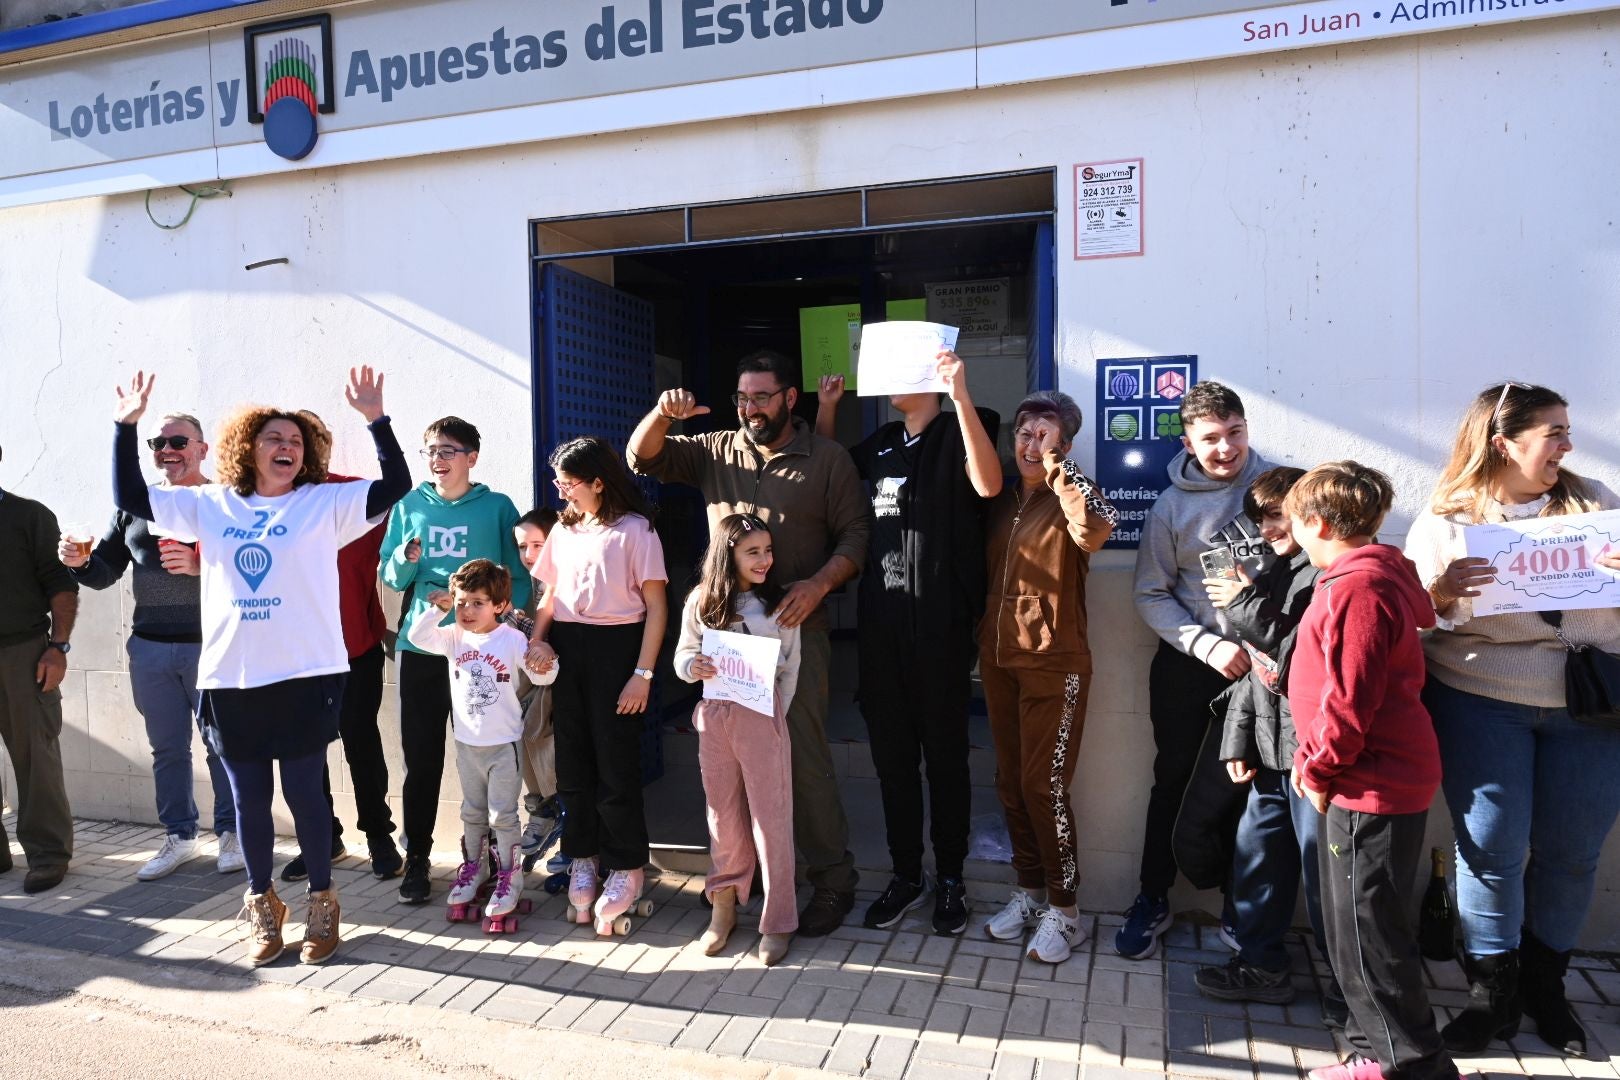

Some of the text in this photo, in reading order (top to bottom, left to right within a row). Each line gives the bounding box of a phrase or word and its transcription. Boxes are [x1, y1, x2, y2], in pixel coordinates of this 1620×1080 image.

[1243, 19, 1289, 42] San
[1298, 9, 1362, 36] Juan
[48, 0, 884, 142] Loterías y Apuestas del Estado
[1083, 187, 1099, 198] 924
[1101, 186, 1115, 196] 312
[1117, 184, 1133, 194] 739
[935, 284, 1000, 296] GRAN PREMIO
[1101, 486, 1158, 500] Loterías
[223, 525, 288, 540] PREIO
[1108, 528, 1143, 541] stad
[1532, 533, 1588, 547] 2 PREMIO
[1530, 570, 1595, 582] VENDIDO AQUÍ
[231, 597, 281, 608] VENDIDO
[241, 608, 270, 621] AQUÍ
